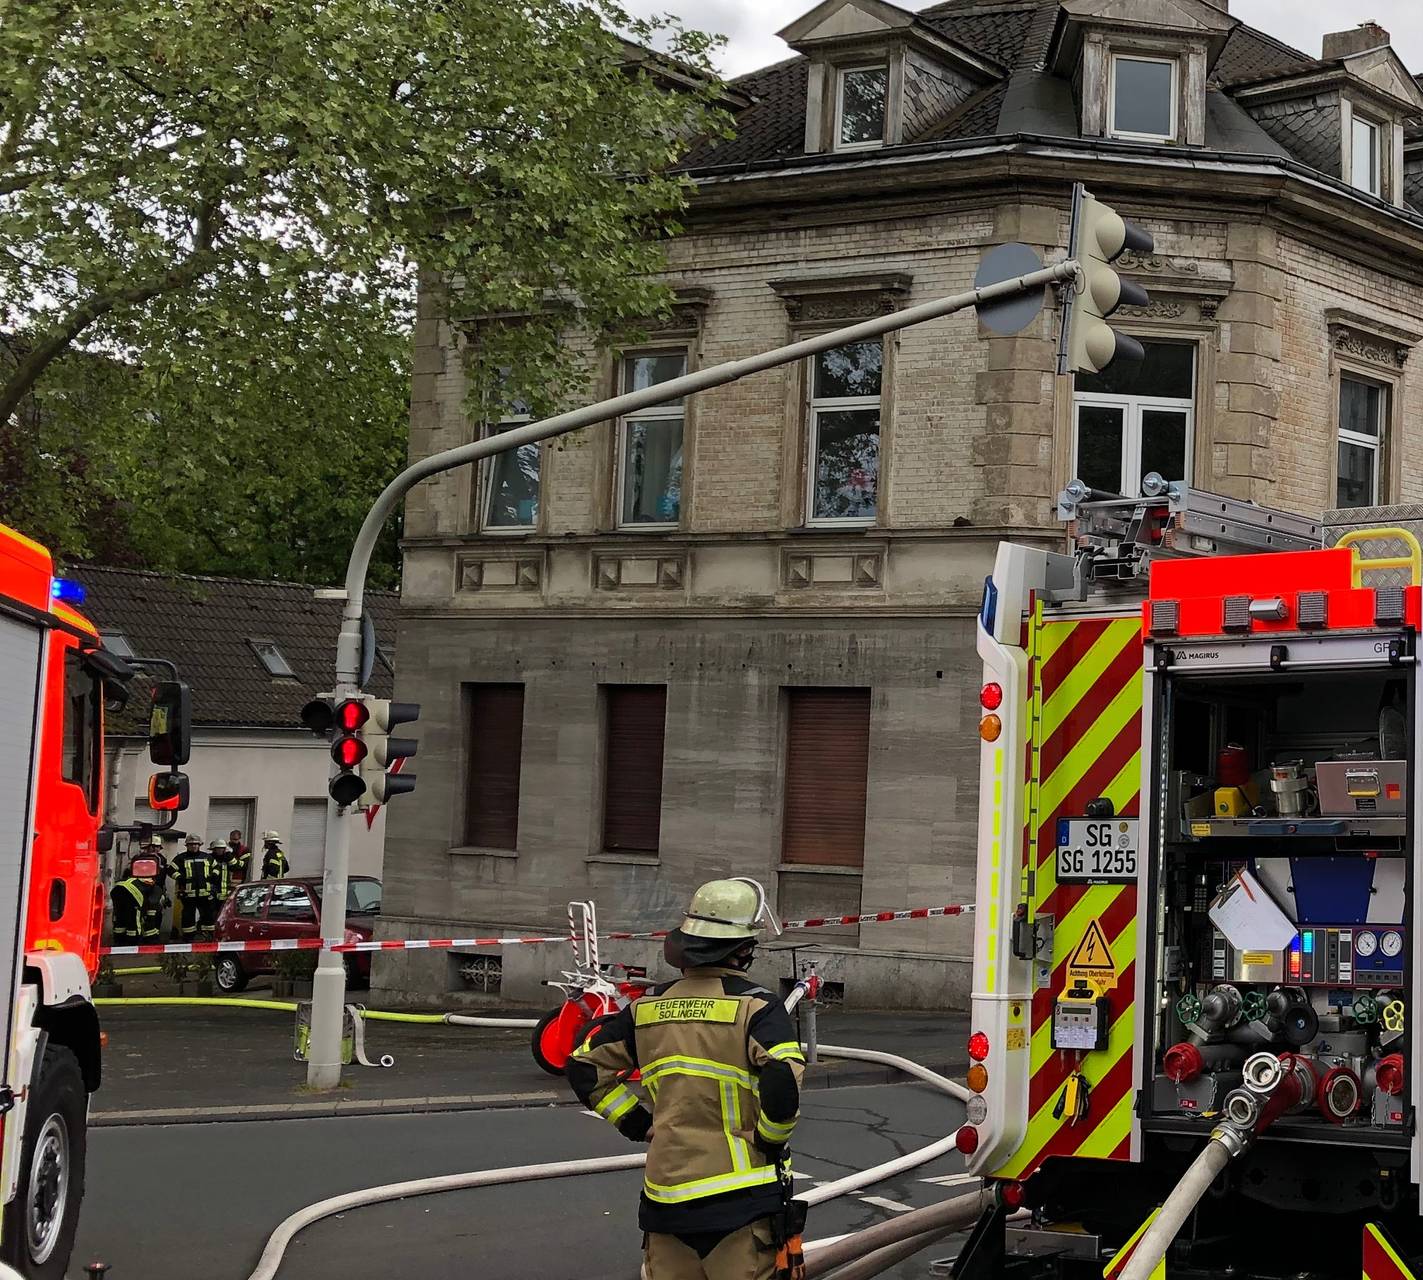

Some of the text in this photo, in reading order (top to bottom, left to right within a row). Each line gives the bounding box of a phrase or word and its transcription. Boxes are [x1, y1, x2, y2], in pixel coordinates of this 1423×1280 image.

[1188, 651, 1219, 660] MAGIRUS
[1086, 824, 1112, 847] SG
[1061, 850, 1136, 874] SG 1255
[1070, 969, 1088, 978] Achtung
[654, 1000, 715, 1010] FEUERWEHR
[658, 1010, 707, 1019] SOLINGEN
